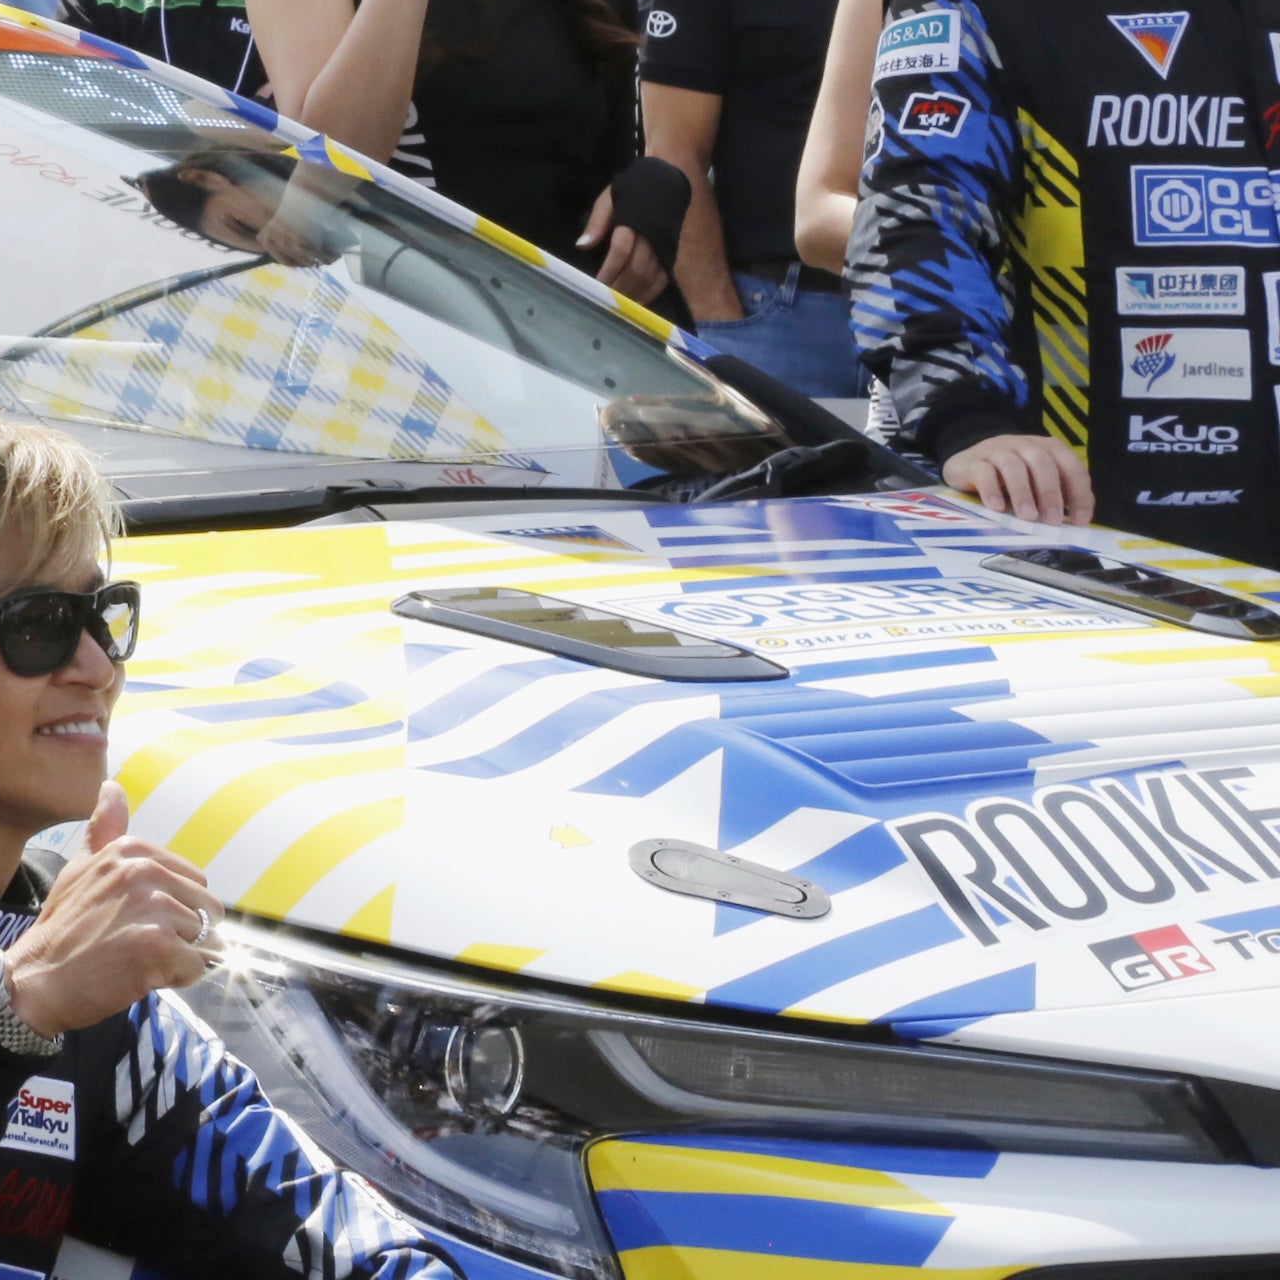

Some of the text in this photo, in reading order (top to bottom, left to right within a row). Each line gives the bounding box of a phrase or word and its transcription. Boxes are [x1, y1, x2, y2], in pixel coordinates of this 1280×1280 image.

[878, 54, 950, 73] 井住友海上
[1087, 93, 1246, 148] ROOKIE
[1158, 274, 1238, 290] 中升集团
[1127, 442, 1239, 455] GROUP
[727, 580, 1019, 608] OGURA
[777, 597, 1077, 624] CLUTCH
[755, 614, 1123, 650] Ogura Racing Clutch
[1111, 943, 1216, 992] GR
[19, 1088, 72, 1115] Super
[17, 1110, 70, 1135] Taikyu
